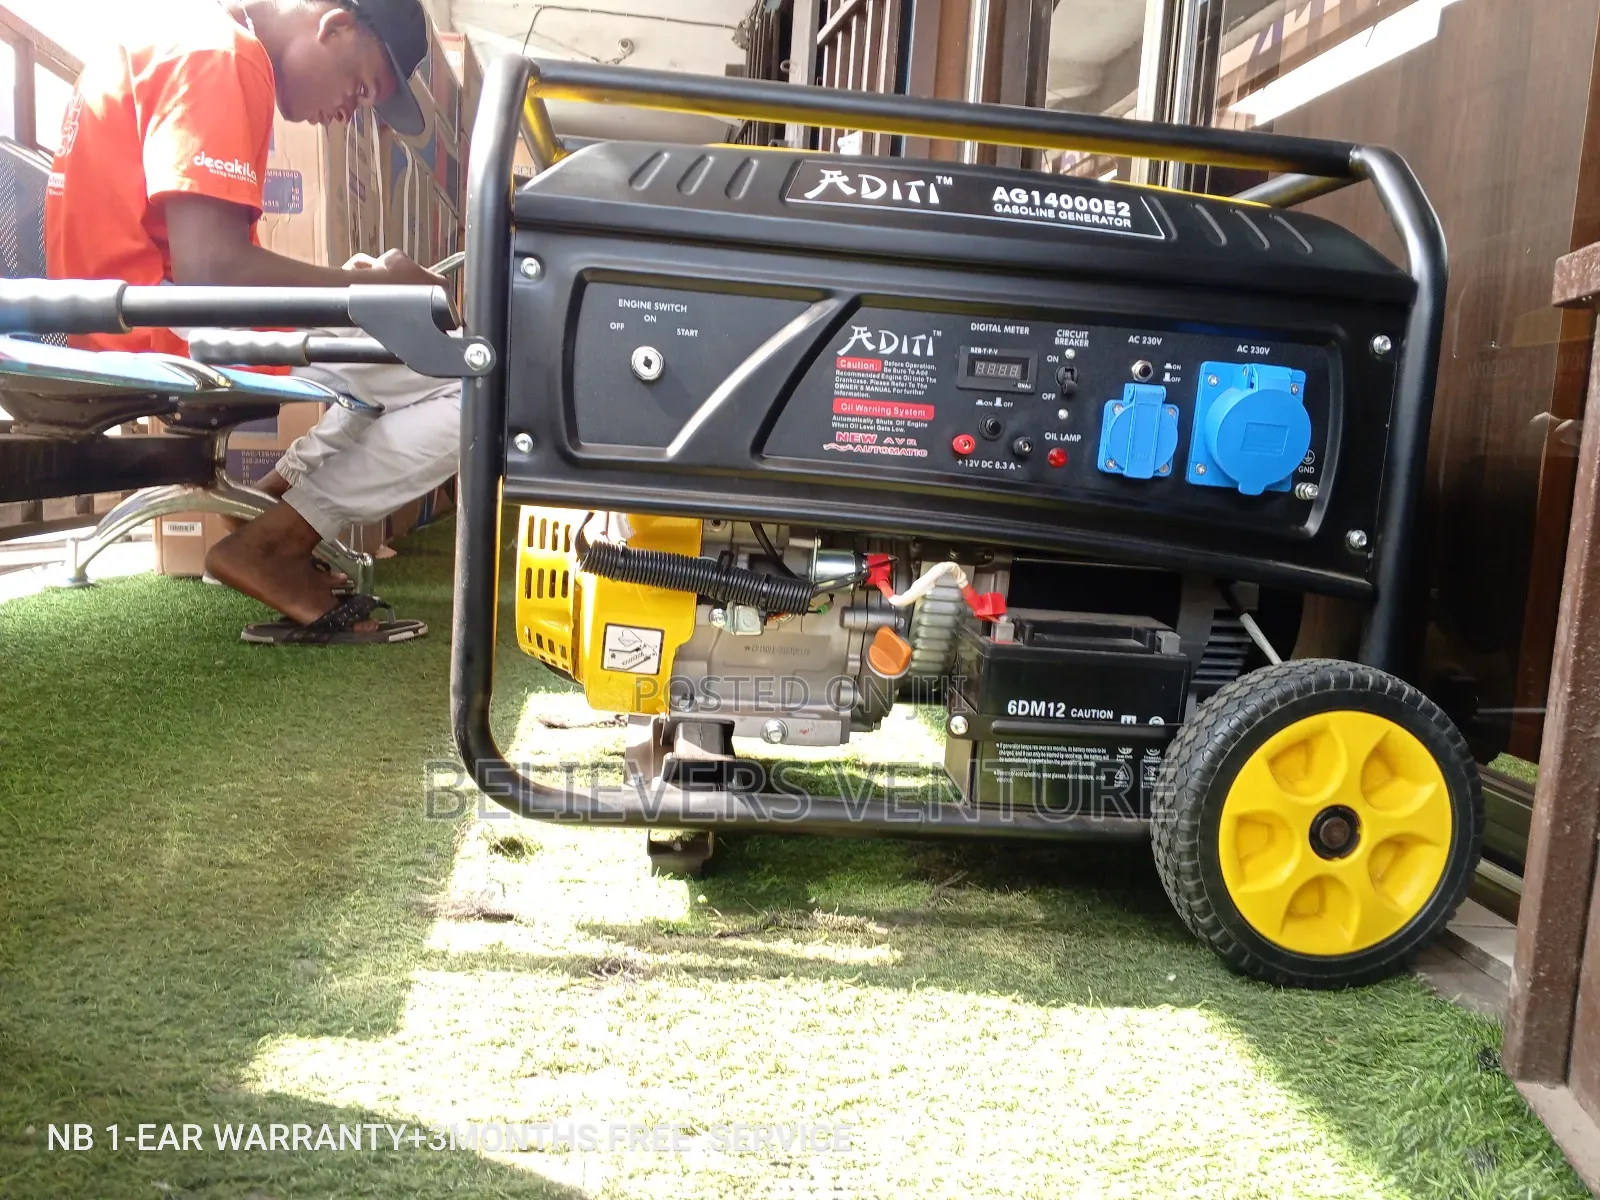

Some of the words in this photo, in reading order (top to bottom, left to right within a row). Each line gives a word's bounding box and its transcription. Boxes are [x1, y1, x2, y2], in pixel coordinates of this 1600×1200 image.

[193, 151, 257, 180] decakila
[804, 168, 940, 204] ADITI
[992, 186, 1130, 216] AG14000E2
[994, 204, 1055, 218] GASOLINE
[1058, 211, 1132, 228] GENERATOR
[618, 298, 651, 310] ENGINE
[654, 302, 687, 313] SWITCH
[644, 314, 657, 322] ON
[610, 322, 625, 330] OFF
[970, 322, 1001, 333] DIGITAL
[1004, 326, 1029, 335] METER
[677, 328, 698, 337] START
[1056, 329, 1089, 339] CIRCUIT
[837, 325, 934, 356] ADITI
[1055, 338, 1089, 347] BREAKER
[1128, 335, 1140, 344] AC
[1142, 336, 1162, 346] 230V
[1237, 345, 1249, 353] AC
[1251, 346, 1270, 355] 230V
[840, 360, 878, 370] Caution:
[835, 370, 880, 379] Recommended
[882, 373, 901, 381] Engine
[866, 385, 891, 393] MANUAL
[841, 403, 853, 411] Oil
[856, 404, 891, 415] Warning
[894, 406, 925, 416] System
[832, 415, 873, 424] Automatically
[907, 420, 928, 428] Engine
[836, 431, 877, 444] NEW
[883, 437, 917, 446] AVR
[1045, 432, 1057, 440] OIL
[1060, 433, 1081, 442] LAMP
[853, 445, 928, 457] AUTOMATIC
[981, 460, 992, 469] DC
[995, 462, 1007, 470] 8.3
[1298, 465, 1315, 474] GND
[1007, 700, 1066, 718] 6DM12
[1070, 708, 1113, 719] CAUTION
